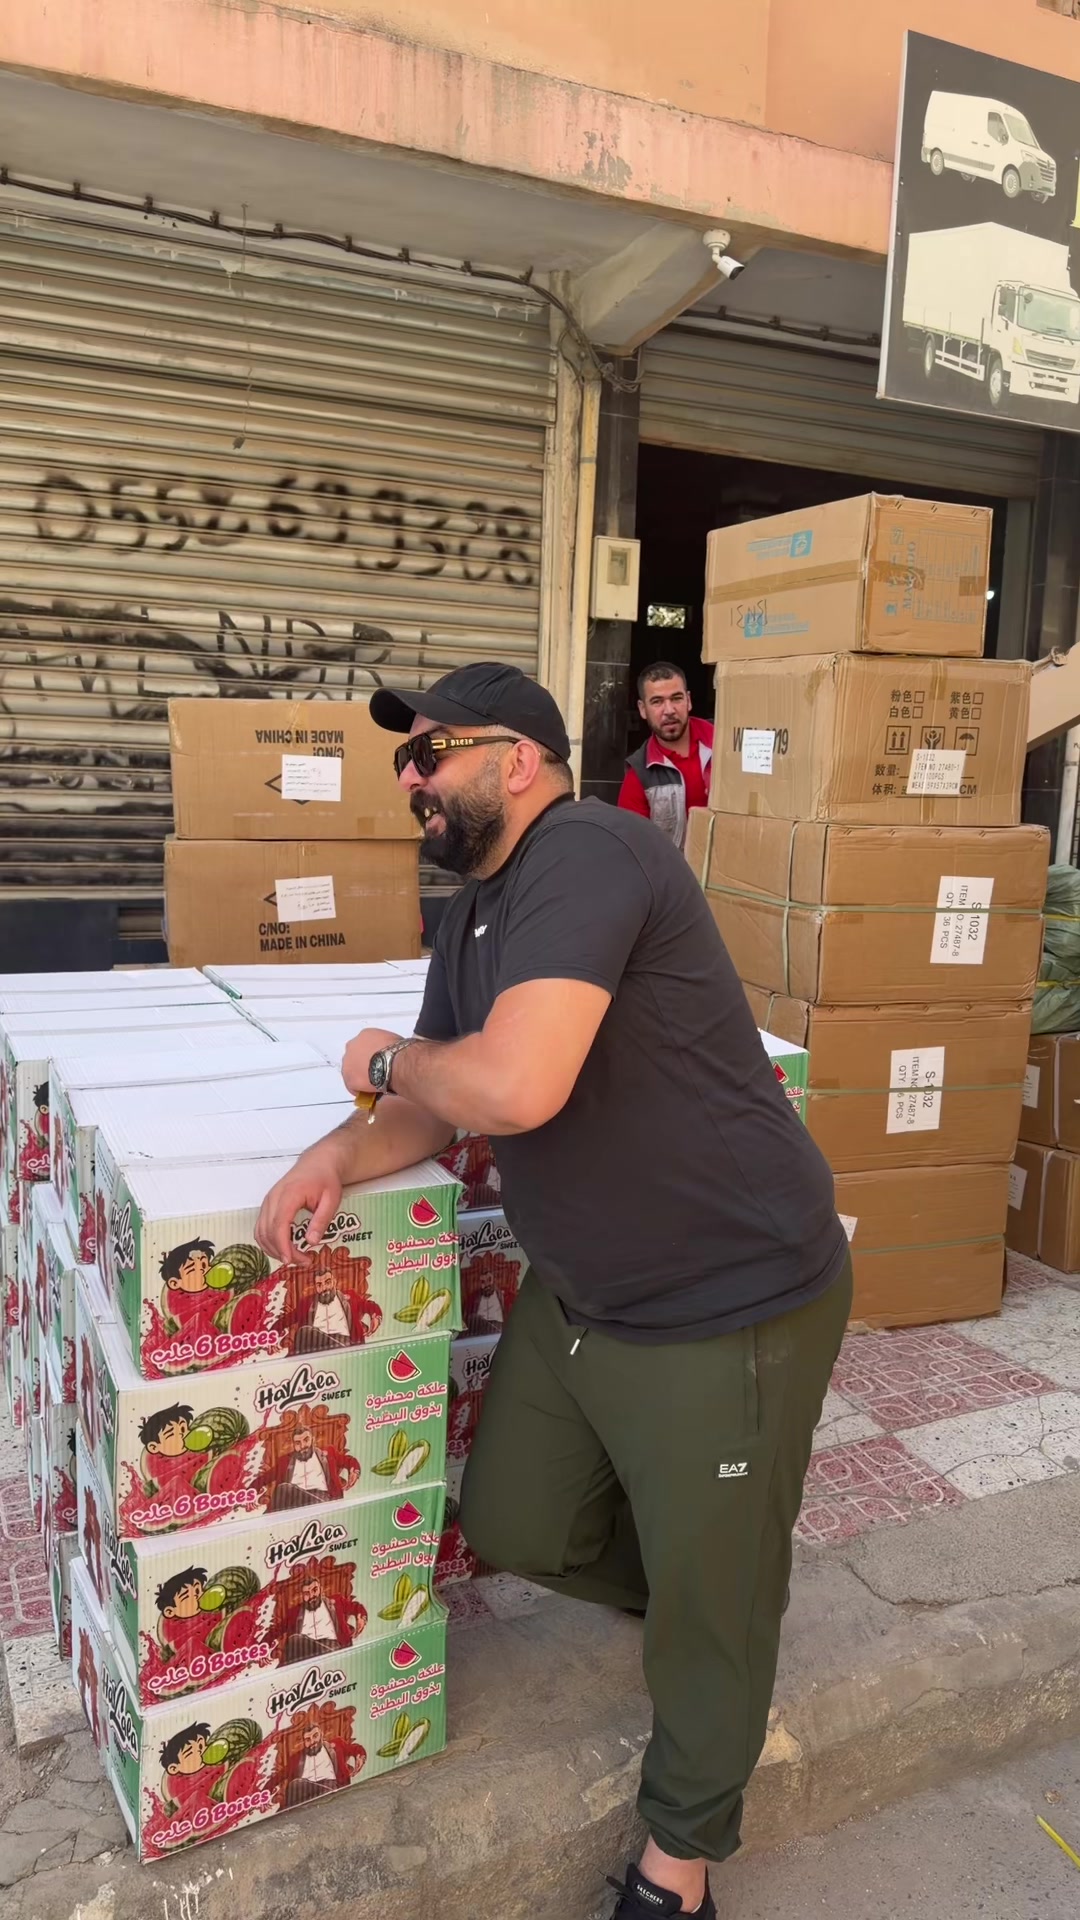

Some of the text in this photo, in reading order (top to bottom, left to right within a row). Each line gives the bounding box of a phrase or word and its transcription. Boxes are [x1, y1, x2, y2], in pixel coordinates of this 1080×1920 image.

[890, 690, 912, 703] 粉色
[950, 691, 971, 705] 紫色
[889, 706, 911, 719] 白色
[949, 707, 970, 720] 黄色
[255, 729, 344, 743] MADE IN CHINA
[959, 784, 977, 795] CM
[958, 885, 968, 906] ITEM
[258, 923, 290, 938] C/NO:
[967, 902, 982, 941] S1032
[260, 933, 346, 952] MADE IN CHINA
[940, 930, 949, 949] PCS
[895, 1101, 904, 1119] PCS
[342, 1231, 373, 1243] SWEET
[387, 1234, 436, 1254] محشوة
[386, 1253, 430, 1277] البطيخ
[150, 1330, 279, 1369] علب 6 Boîtes
[321, 1388, 352, 1402] SWEET
[366, 1380, 448, 1411] علكة محشوة
[364, 1402, 442, 1431] بذوق البطيخ
[719, 1462, 748, 1474] EA7
[130, 1488, 257, 1528] علب 6 Boîtes
[329, 1538, 358, 1553] SWEET
[370, 1537, 418, 1558] محشوة
[370, 1554, 411, 1579] البطيخ
[147, 1642, 269, 1695] علب 6 Boîtes
[329, 1682, 358, 1699] SWEET
[369, 1663, 446, 1700] علكة محشوة
[369, 1682, 442, 1720] بذوق البطيخ
[151, 1790, 271, 1848] علب 6 Boîtes
